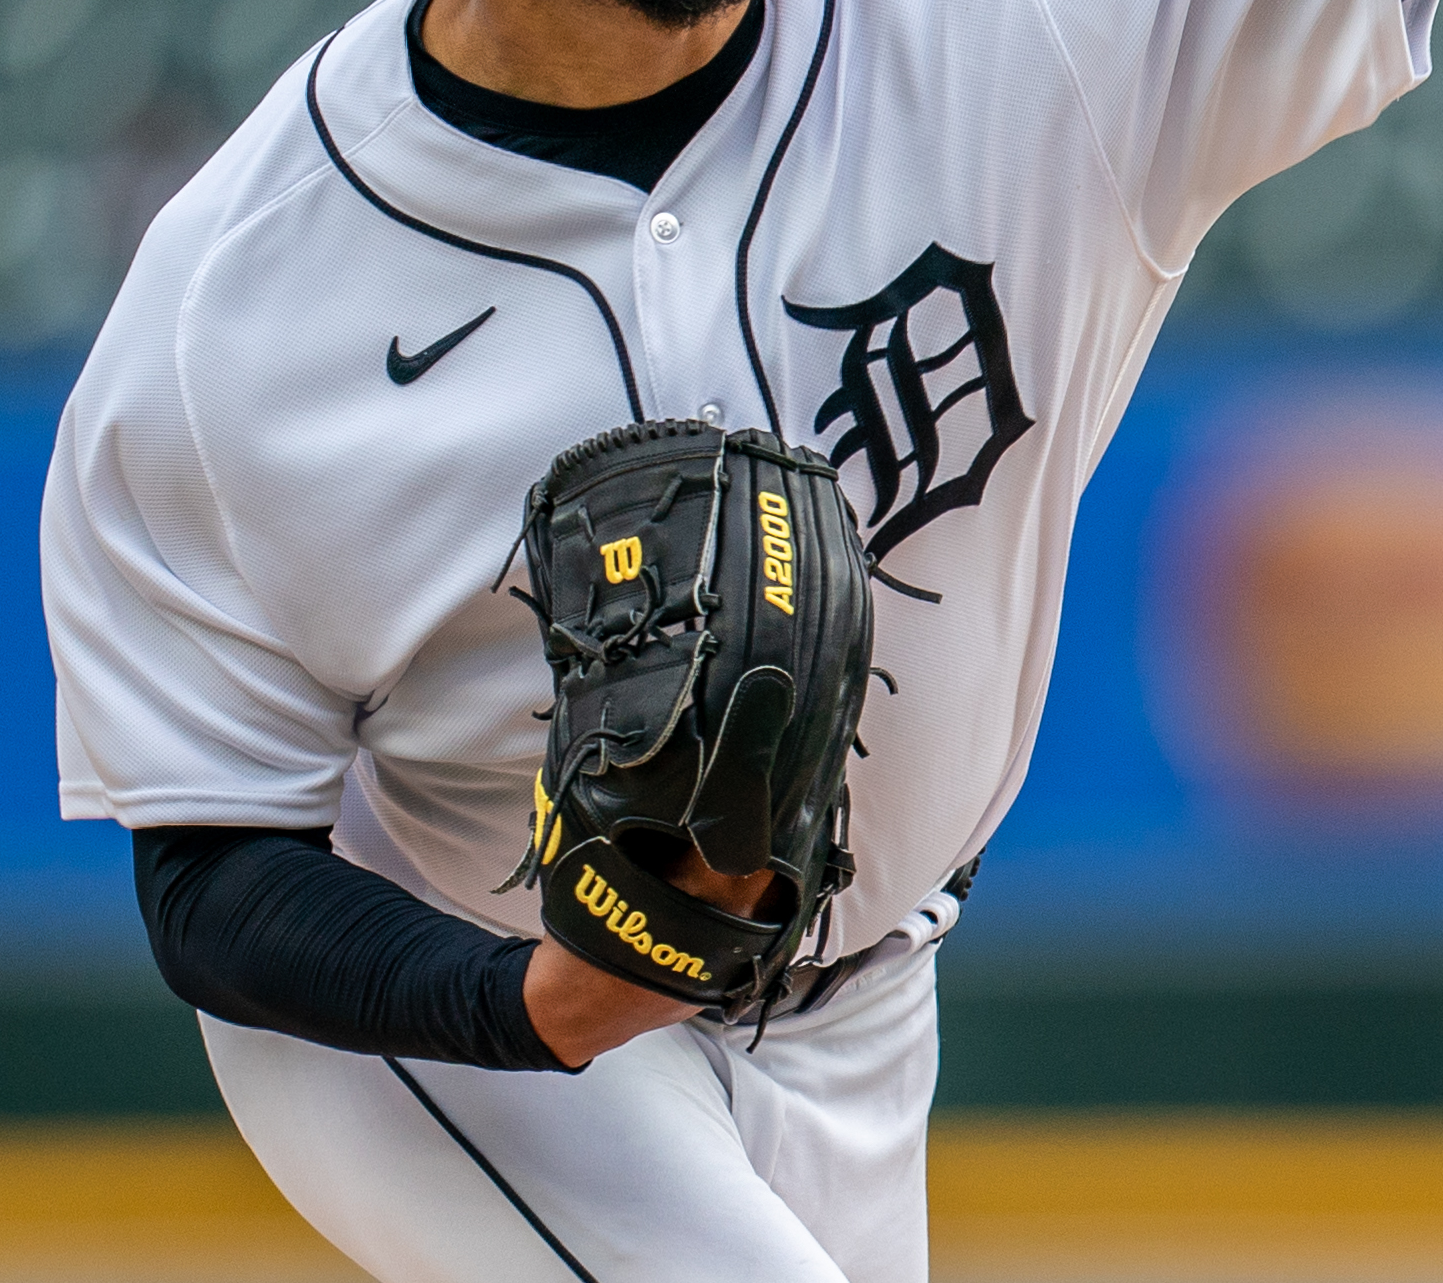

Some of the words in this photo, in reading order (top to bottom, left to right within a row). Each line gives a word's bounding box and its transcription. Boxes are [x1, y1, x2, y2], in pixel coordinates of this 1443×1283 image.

[781, 241, 1037, 567] D
[757, 490, 795, 616] A2000
[574, 863, 706, 980] Wilson
